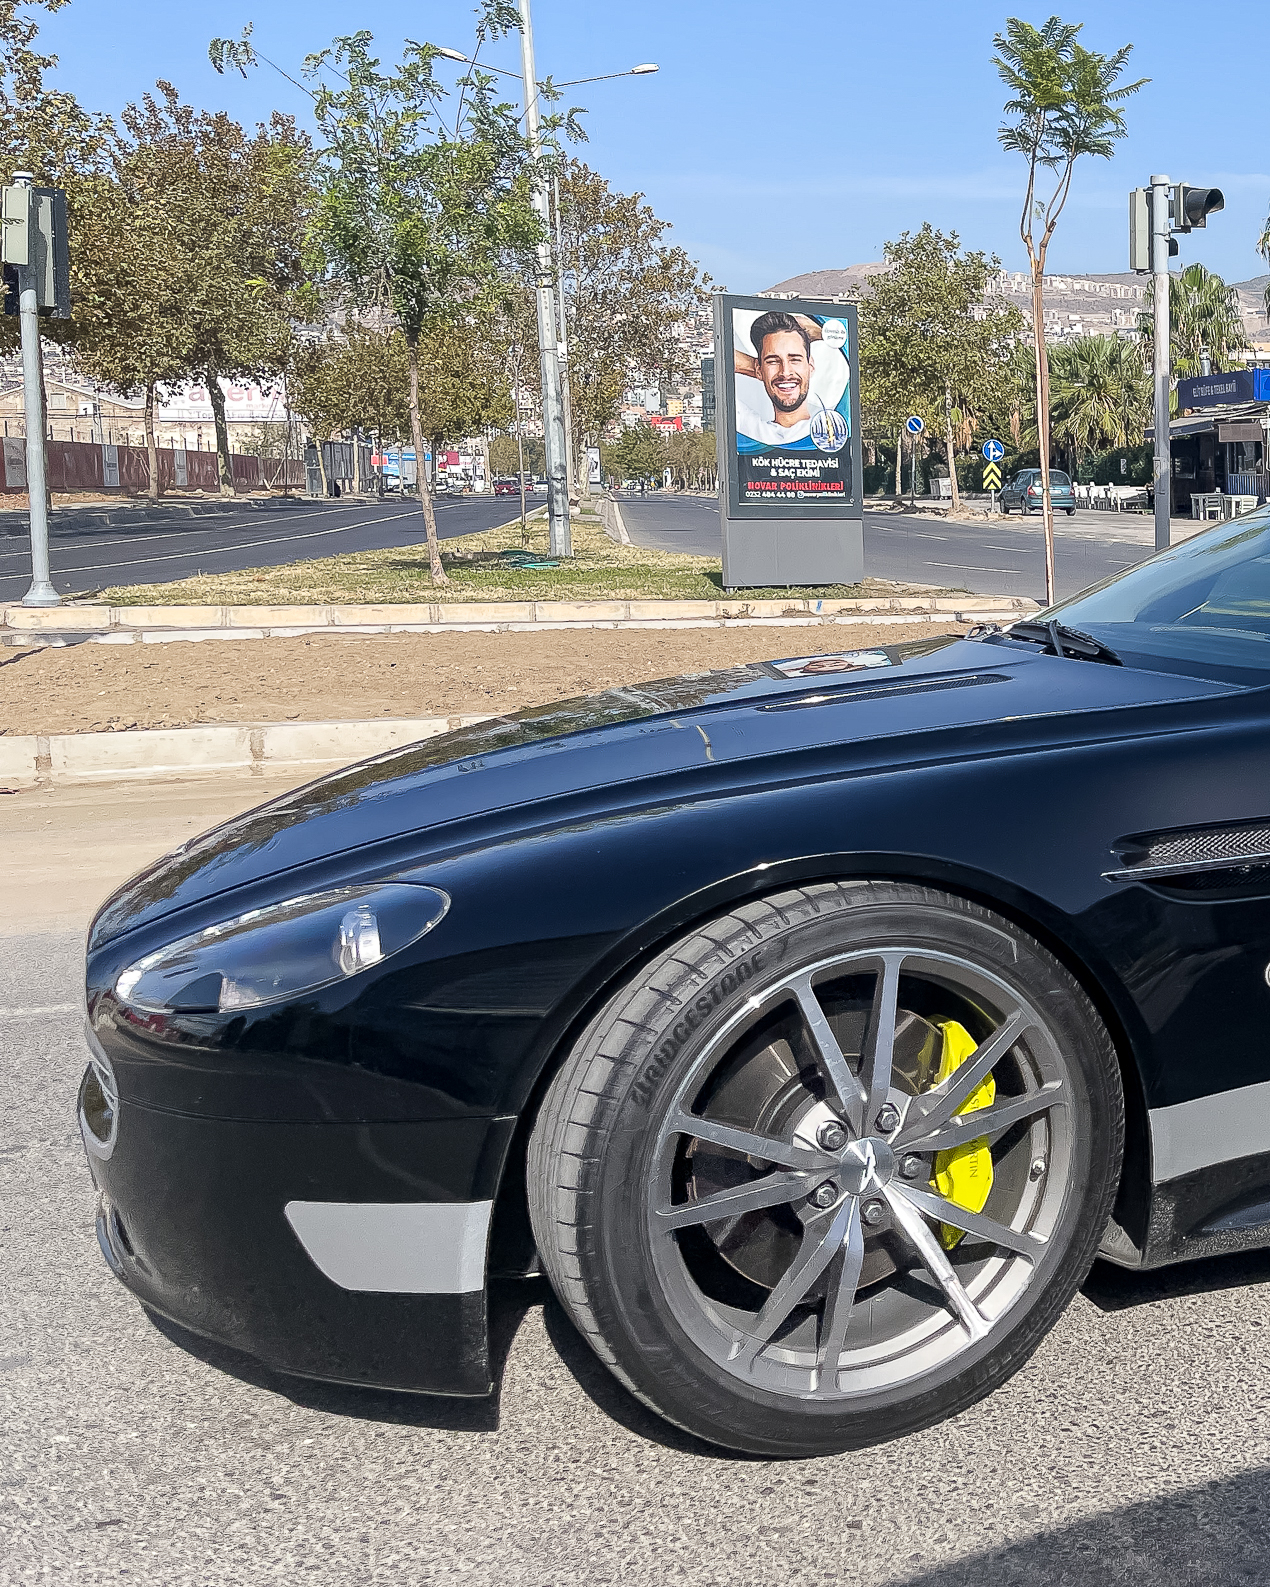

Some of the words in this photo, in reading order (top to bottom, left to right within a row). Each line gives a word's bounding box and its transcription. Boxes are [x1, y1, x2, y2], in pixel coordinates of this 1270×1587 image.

[752, 456, 770, 467] KÖK
[772, 456, 800, 468] HÜCRE
[801, 457, 839, 468] TEDAVİSİ
[770, 468, 777, 476] &
[778, 468, 795, 479] SAÇ
[797, 467, 820, 477] EKİMİ
[630, 951, 767, 1105] BRIDGESTONE
